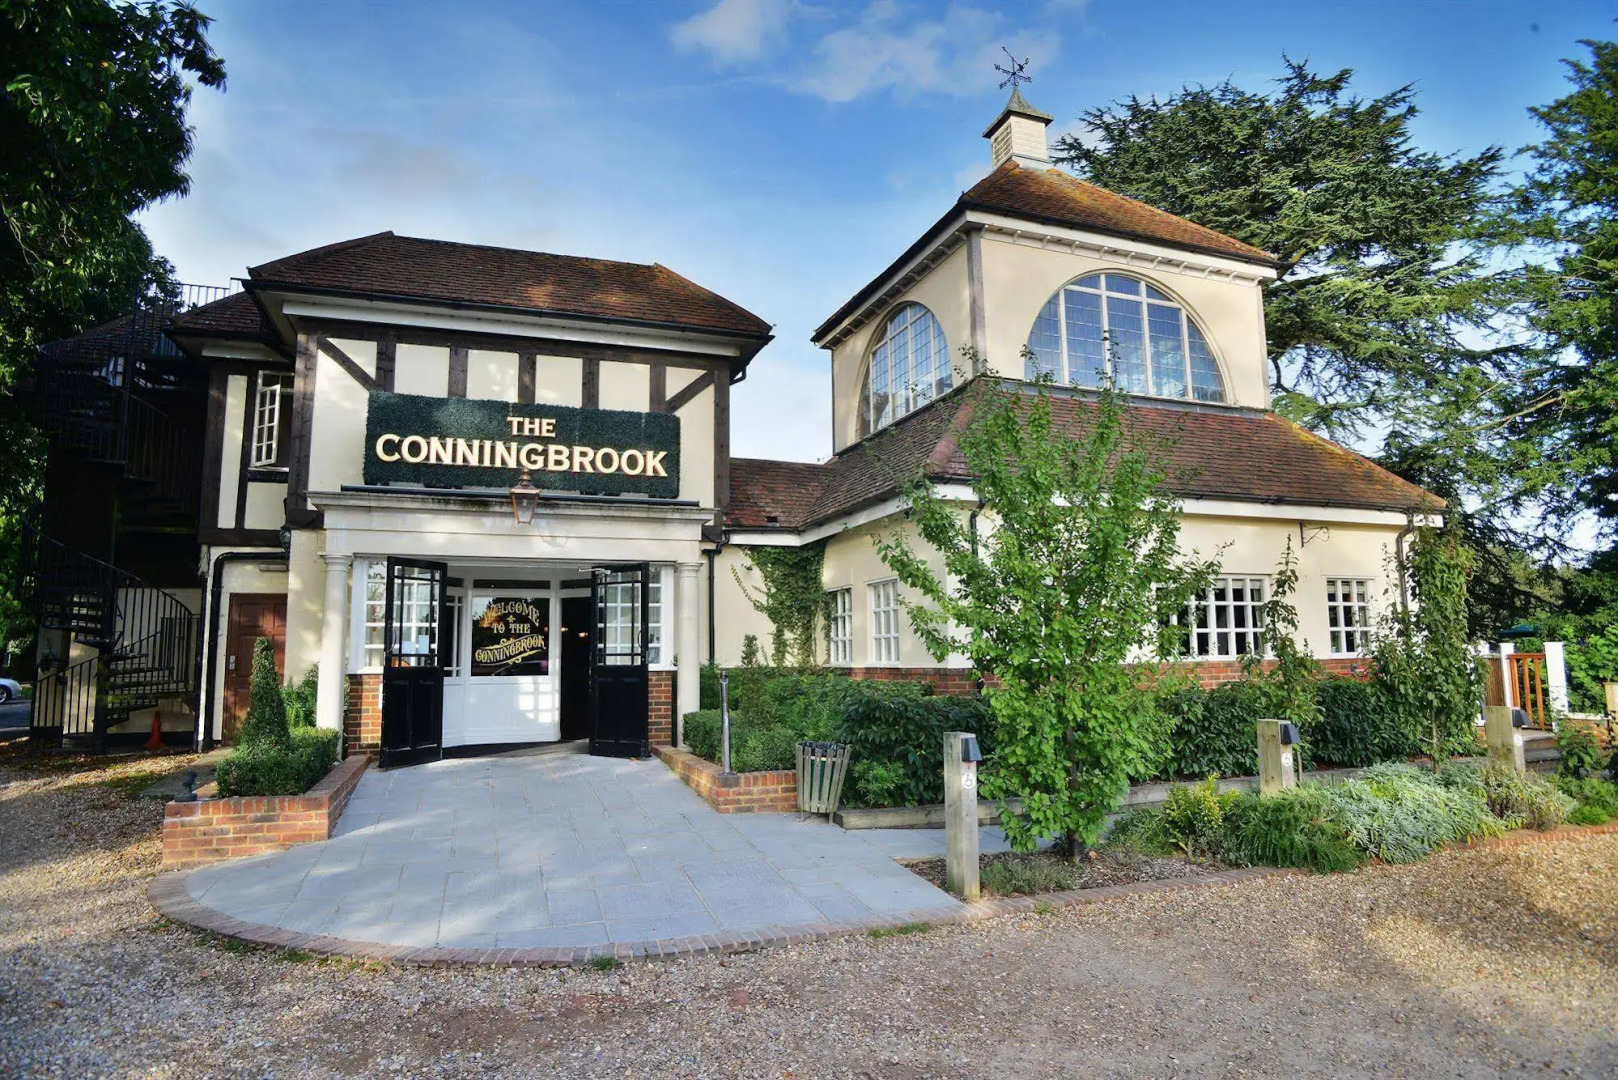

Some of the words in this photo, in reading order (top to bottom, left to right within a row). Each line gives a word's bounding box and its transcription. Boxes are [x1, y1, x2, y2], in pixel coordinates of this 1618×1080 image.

[507, 416, 556, 437] THE
[375, 433, 668, 477] CONNINGBROOK
[484, 600, 540, 627] WELCOME
[491, 623, 505, 634] TO
[509, 623, 531, 634] THE
[475, 636, 547, 662] CONNINGBROOK
